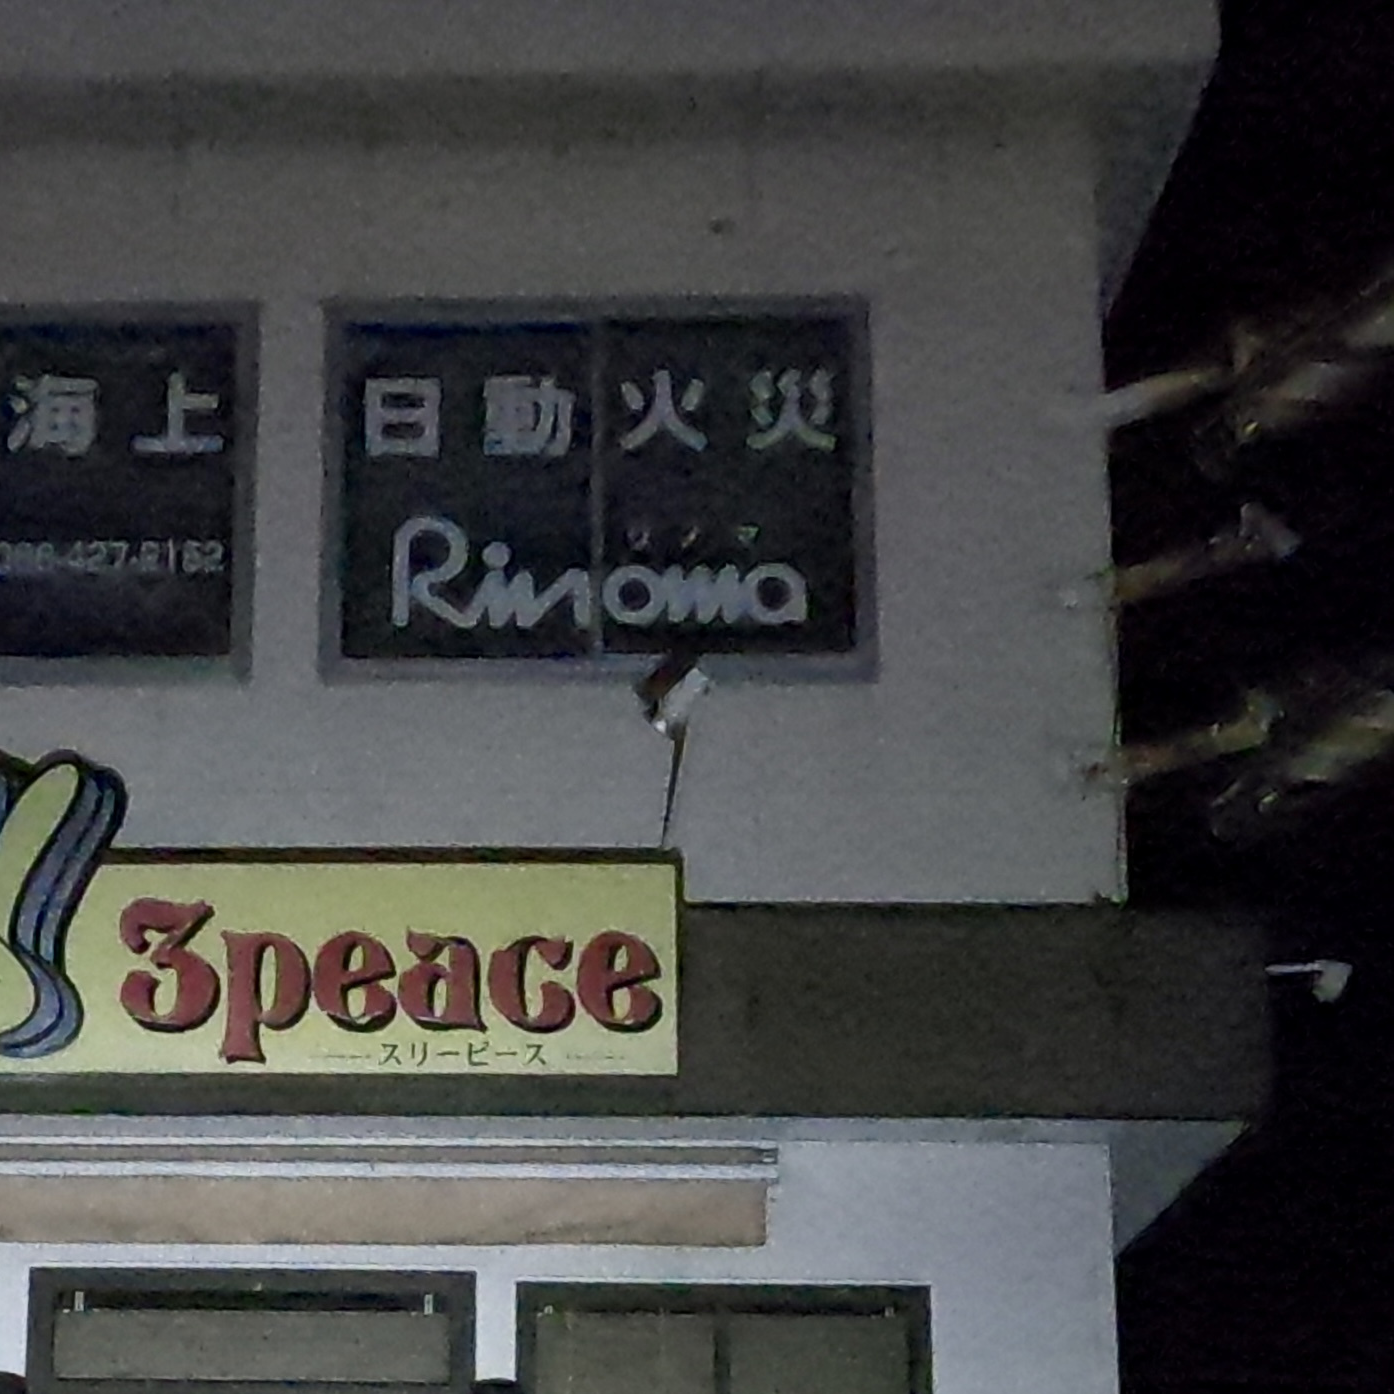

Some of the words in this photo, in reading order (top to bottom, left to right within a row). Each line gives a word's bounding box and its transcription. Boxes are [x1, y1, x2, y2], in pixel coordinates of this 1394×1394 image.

[363, 367, 836, 458] 日動火災
[119, 897, 663, 1065] 3peace
[377, 1041, 548, 1067] スリーピース
